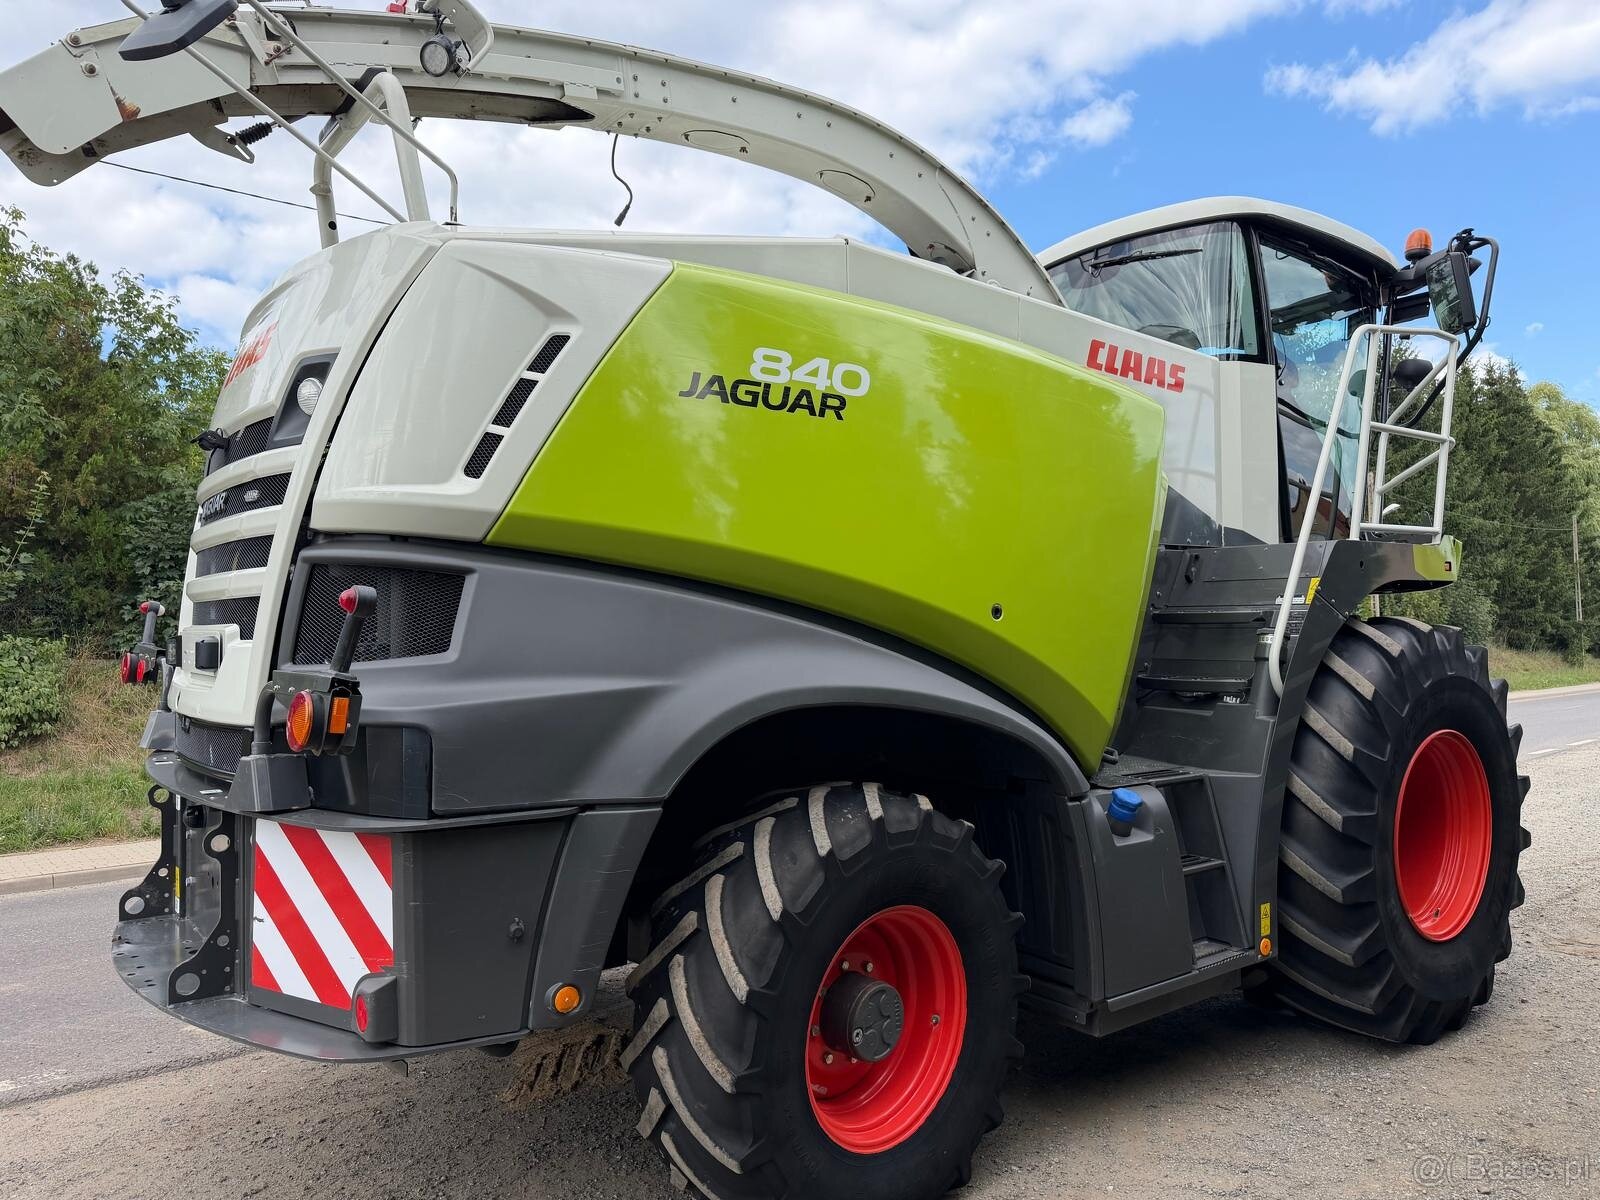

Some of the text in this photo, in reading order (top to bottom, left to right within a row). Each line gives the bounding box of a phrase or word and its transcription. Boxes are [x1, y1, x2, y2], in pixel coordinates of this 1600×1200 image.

[750, 347, 870, 397] 840
[1086, 339, 1185, 393] CLAAS
[679, 371, 847, 421] JAGUAR
